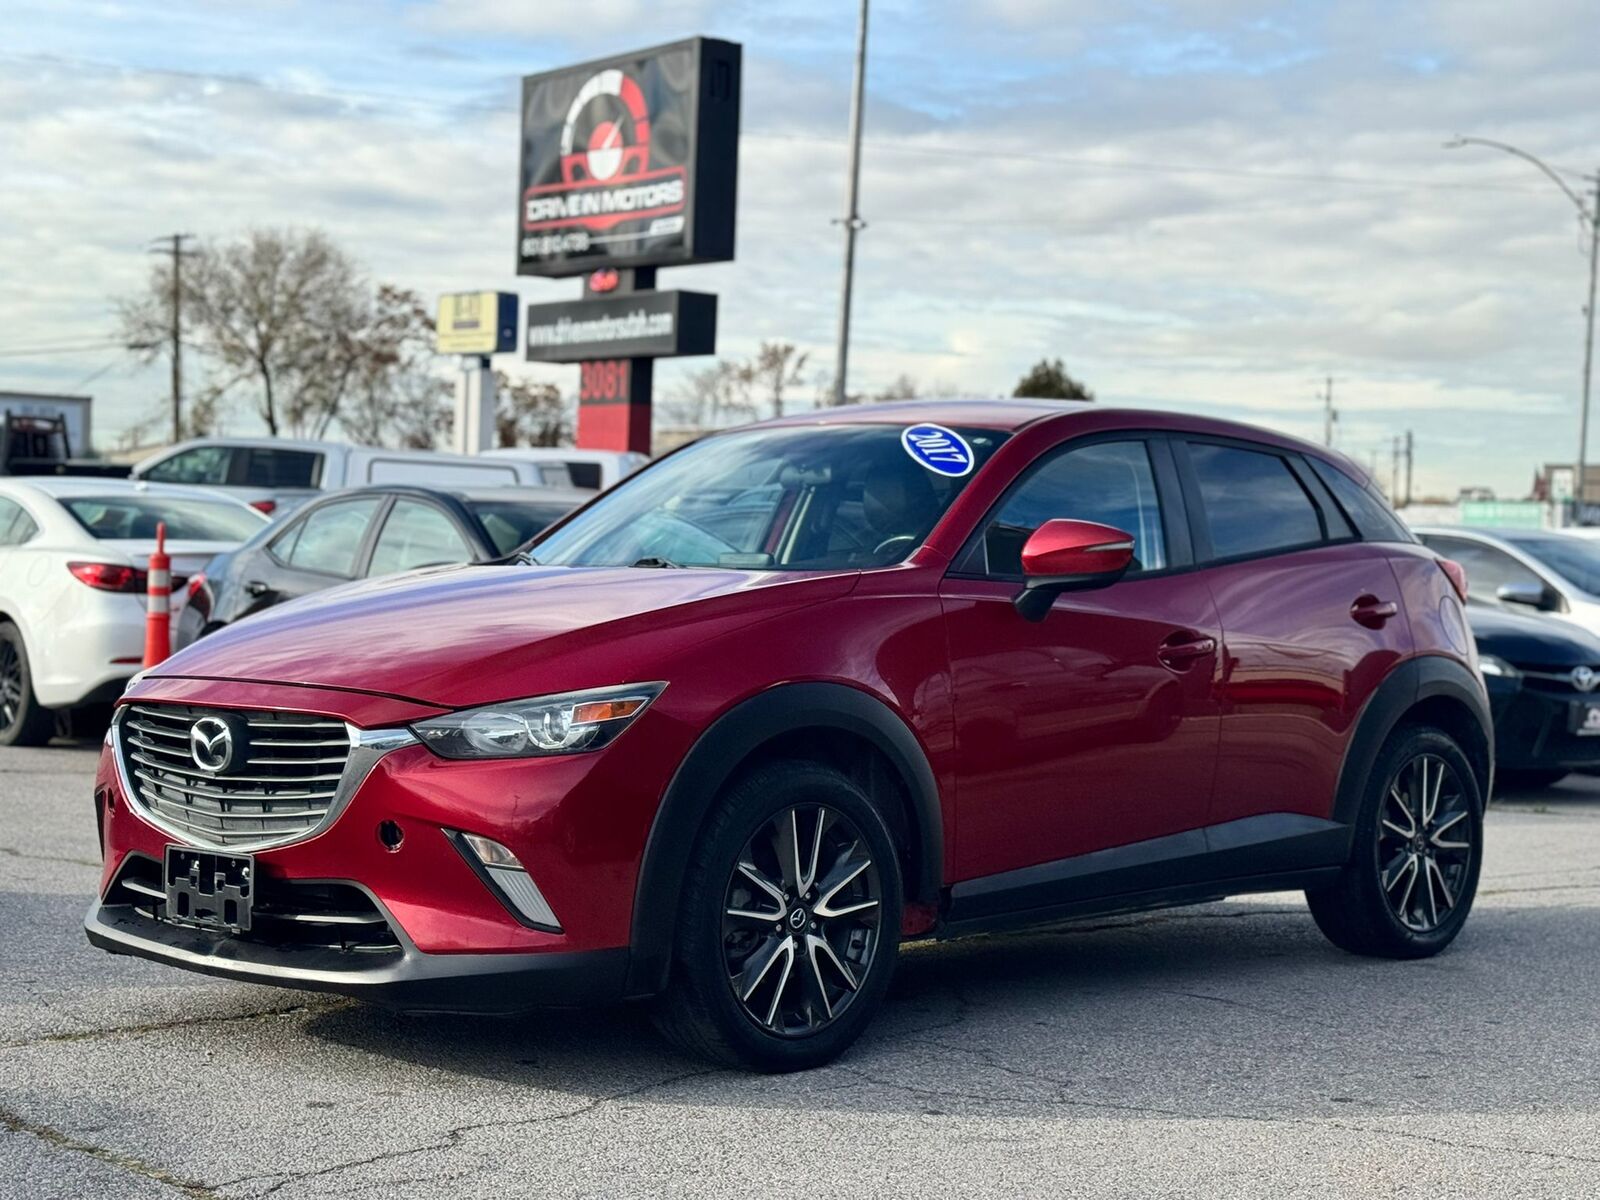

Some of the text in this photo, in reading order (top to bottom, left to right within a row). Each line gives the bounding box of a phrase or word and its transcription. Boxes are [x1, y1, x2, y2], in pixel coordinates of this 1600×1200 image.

[526, 180, 684, 222] DRIVEN MOTORS
[580, 360, 626, 400] 3081
[907, 431, 968, 463] 2017
